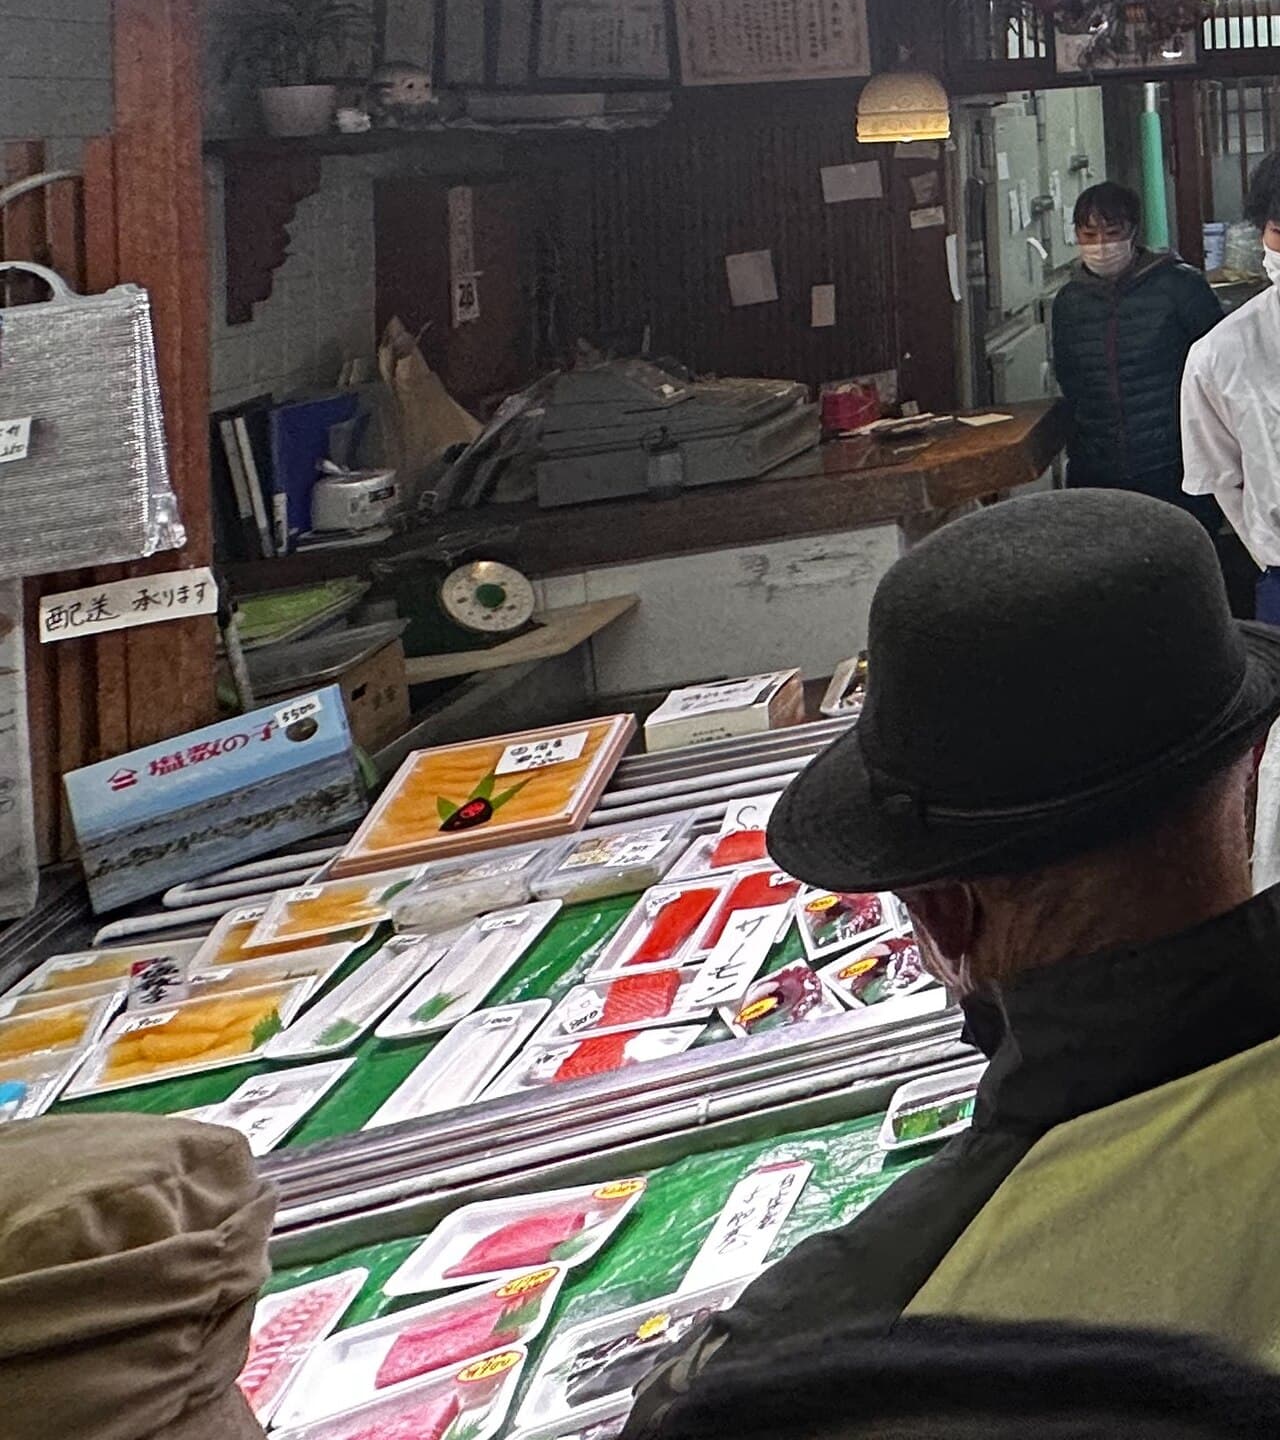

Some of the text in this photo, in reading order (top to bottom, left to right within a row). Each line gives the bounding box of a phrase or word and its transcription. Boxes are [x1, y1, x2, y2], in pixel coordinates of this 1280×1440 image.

[45, 582, 208, 632] 配送 承ります
[148, 720, 277, 776] 塩数の子
[696, 914, 771, 1004] サーモン
